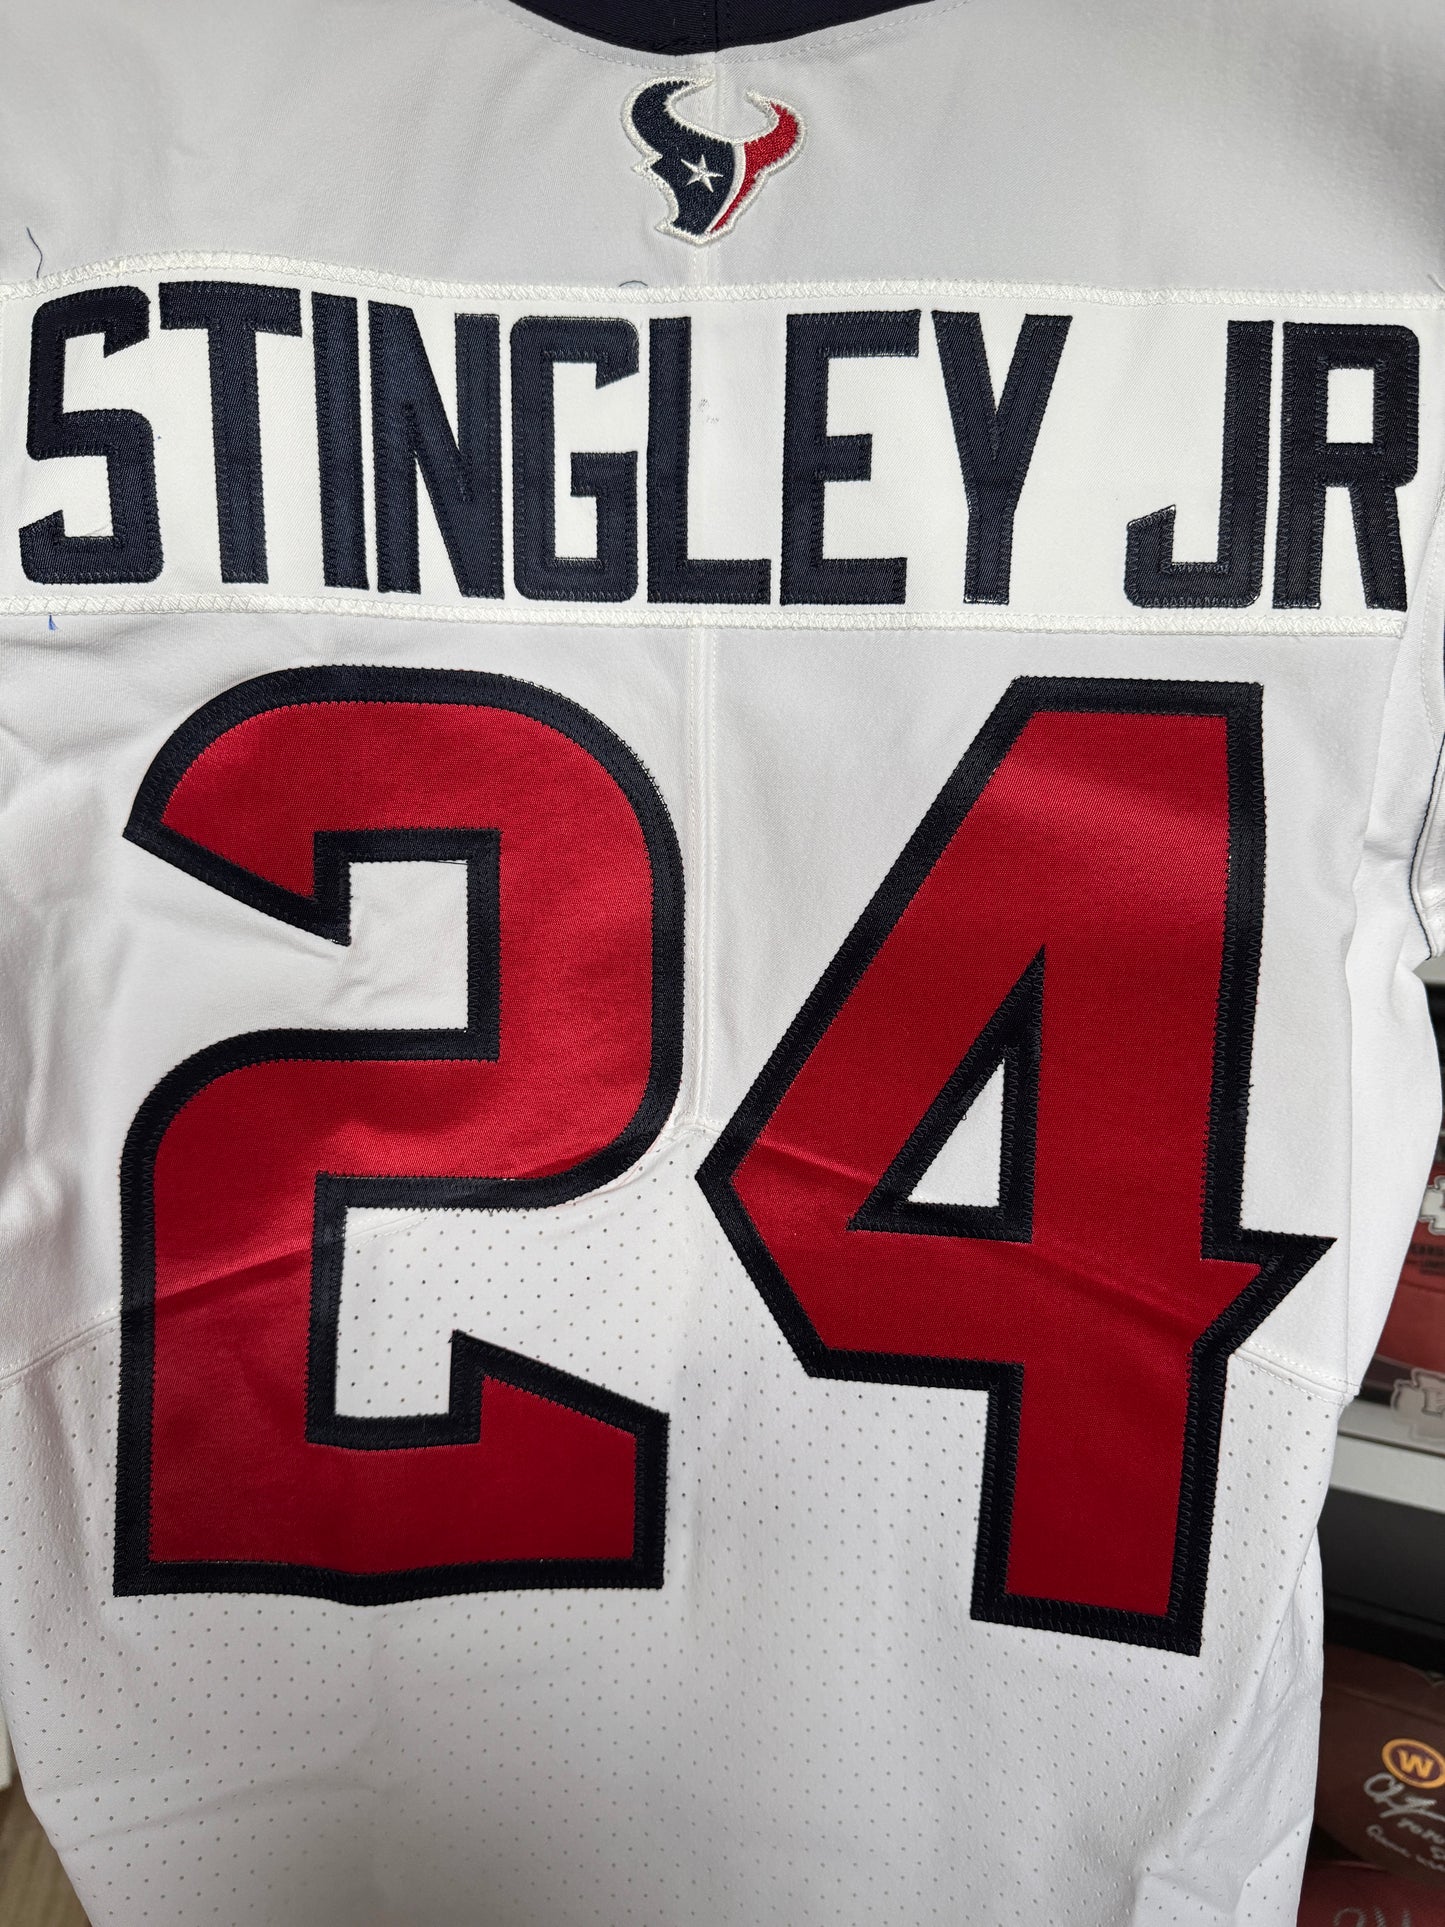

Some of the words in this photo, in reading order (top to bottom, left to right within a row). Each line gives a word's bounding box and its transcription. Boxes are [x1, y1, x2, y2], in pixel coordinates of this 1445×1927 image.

[19, 281, 1072, 605] STINGLEY
[1124, 320, 1420, 611] JR
[113, 664, 1335, 1657] 24
[1398, 1748, 1434, 1779] W
